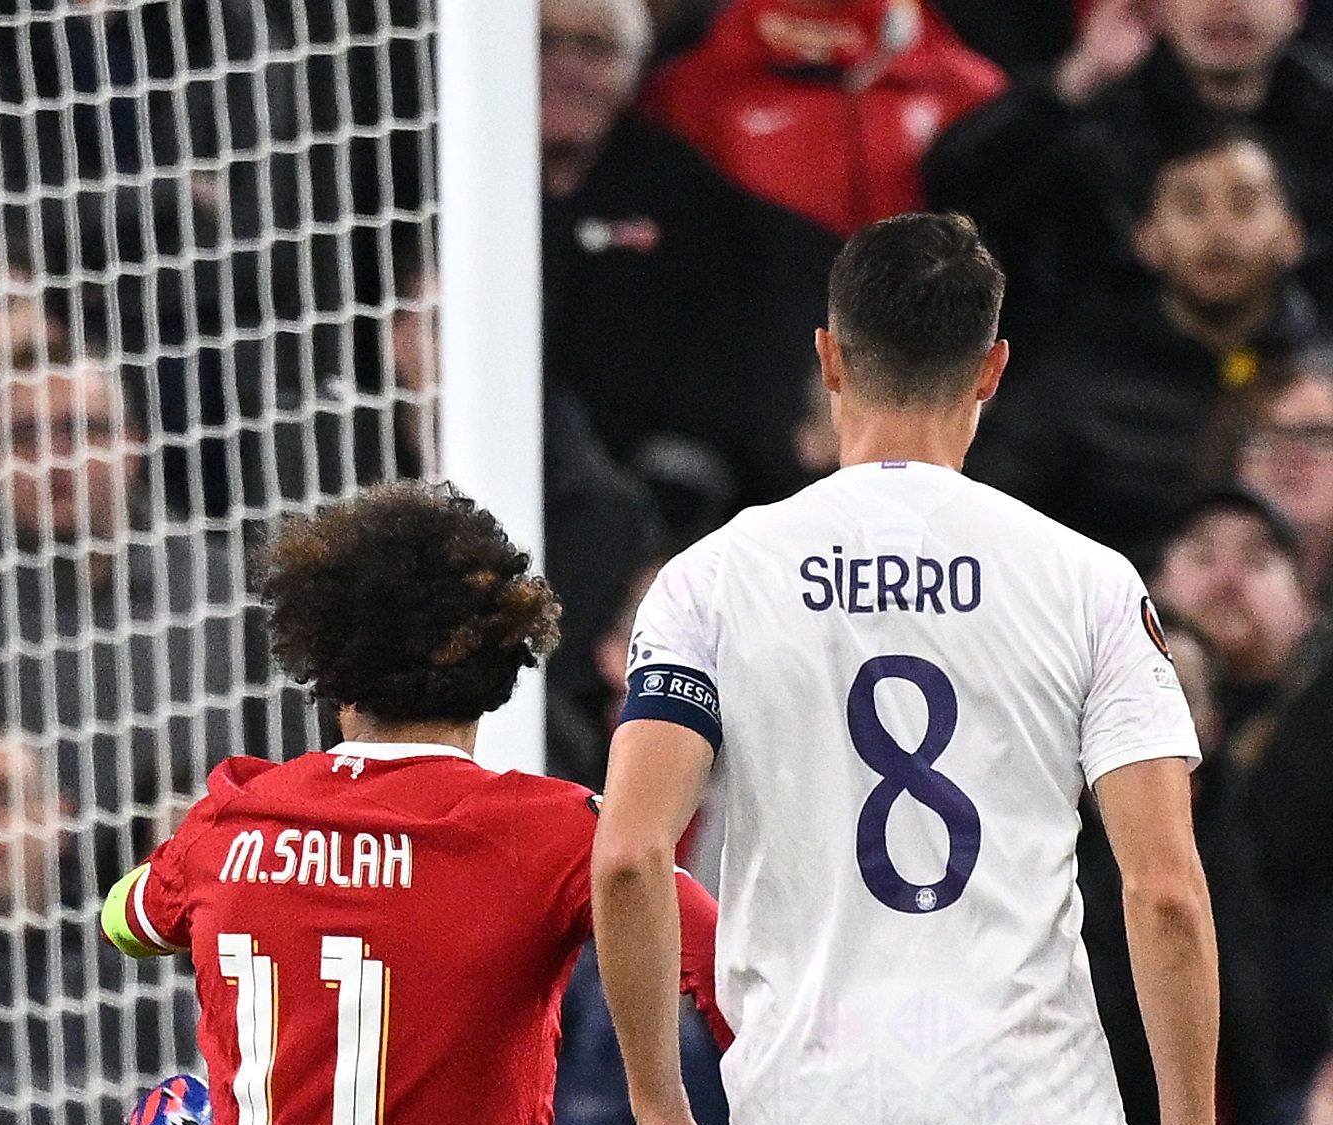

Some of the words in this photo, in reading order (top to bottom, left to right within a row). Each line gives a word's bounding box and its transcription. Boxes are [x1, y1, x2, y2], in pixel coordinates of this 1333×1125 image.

[670, 678, 721, 716] RESPE
[847, 655, 981, 914] 8
[219, 828, 413, 888] M.SALAH
